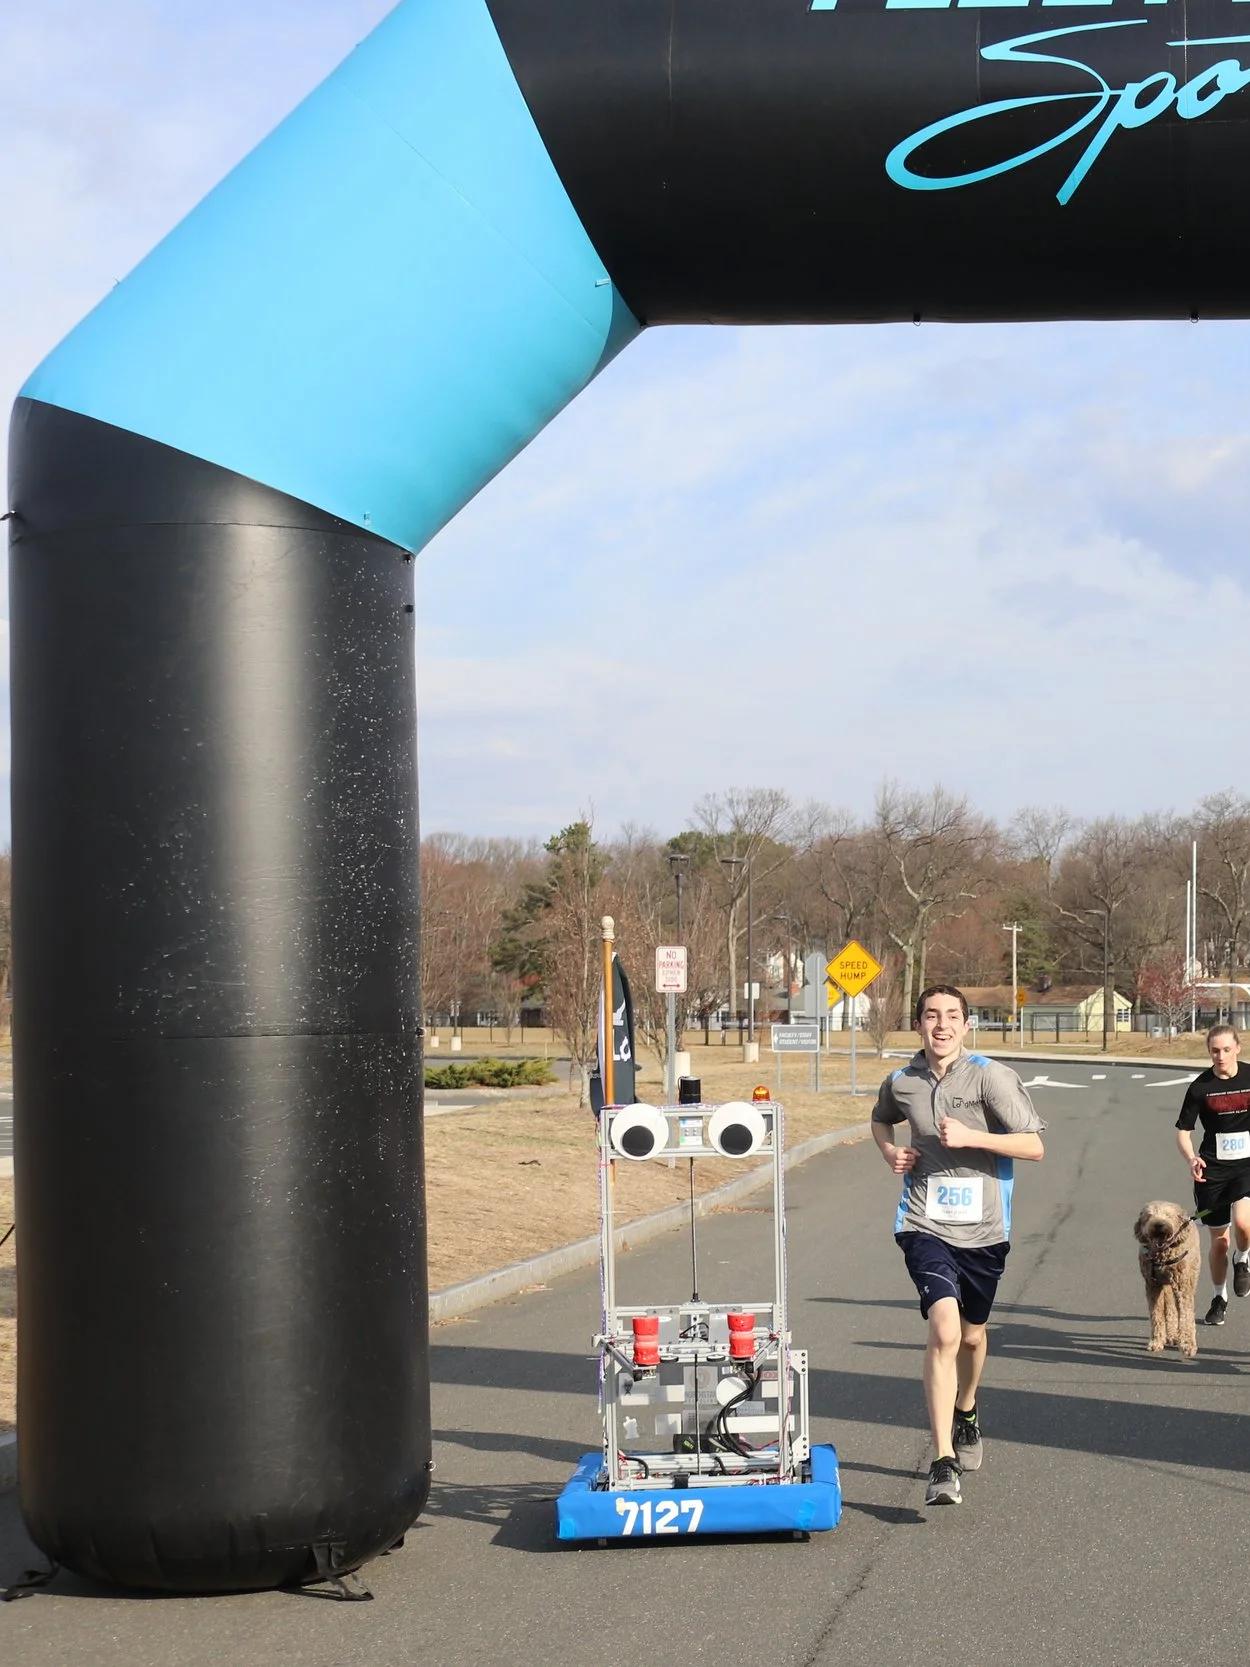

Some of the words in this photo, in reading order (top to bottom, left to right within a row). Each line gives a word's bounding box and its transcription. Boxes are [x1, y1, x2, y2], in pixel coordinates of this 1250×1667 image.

[666, 950, 677, 960] NO
[658, 960, 685, 970] PARKING
[839, 961, 868, 970] SPEED
[840, 972, 867, 981] HUMP
[937, 1185, 973, 1207] 256
[615, 1498, 704, 1536] 7127
